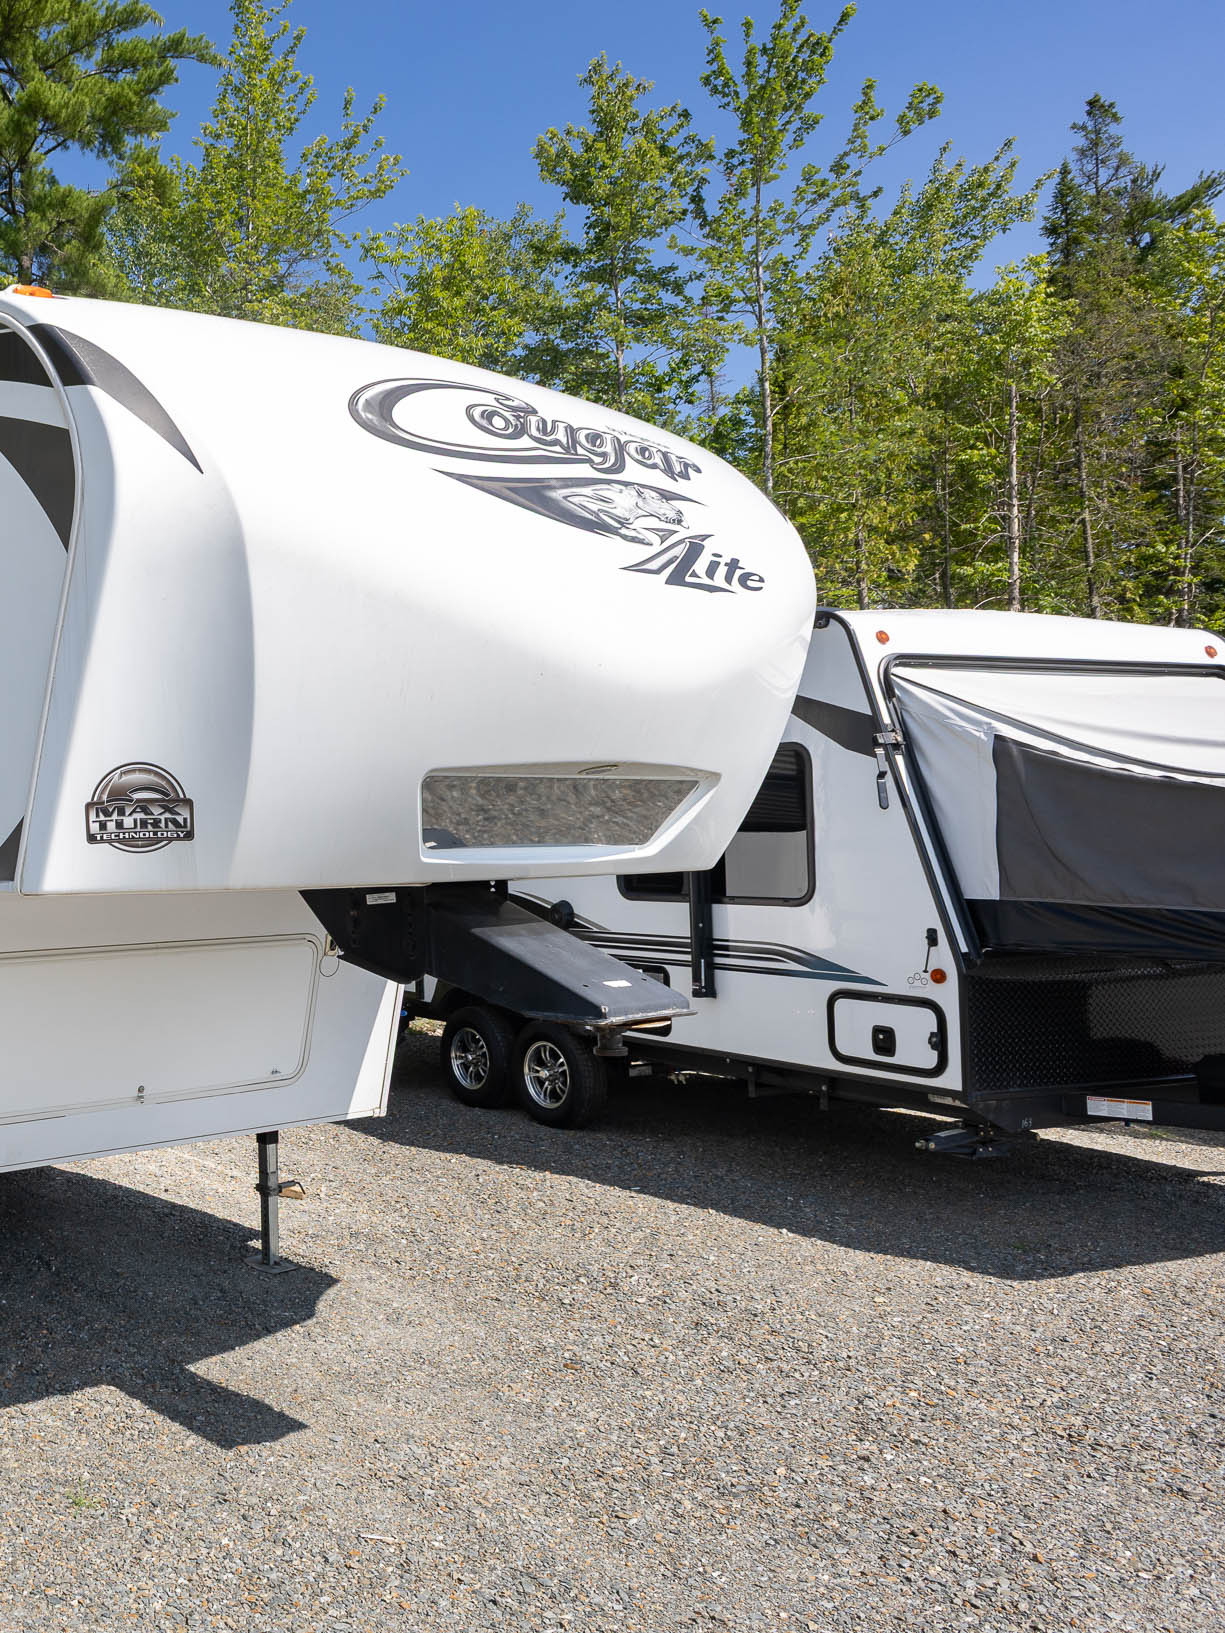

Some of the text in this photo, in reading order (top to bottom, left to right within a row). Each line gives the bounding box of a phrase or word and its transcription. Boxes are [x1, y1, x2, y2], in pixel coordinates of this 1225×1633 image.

[348, 378, 702, 482] Cougar
[94, 803, 185, 818] MAX
[91, 817, 188, 831] TURN
[94, 831, 187, 841] TECHNOLOGY
